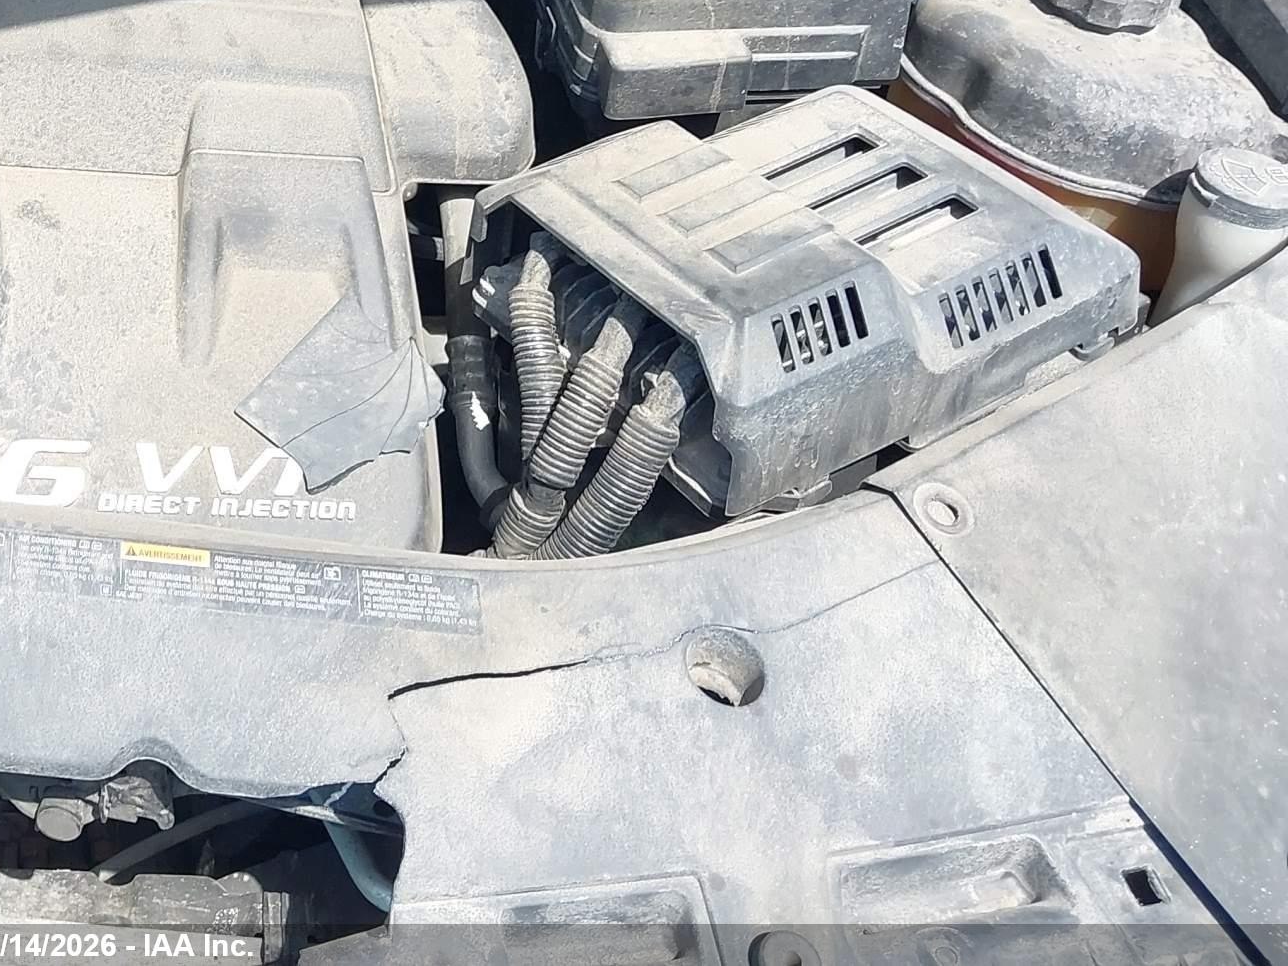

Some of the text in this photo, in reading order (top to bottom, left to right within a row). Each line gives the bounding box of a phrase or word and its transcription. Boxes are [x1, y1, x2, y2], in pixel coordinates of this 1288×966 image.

[97, 493, 357, 520] DIRECT INJECTION
[138, 548, 203, 562] AVERTISSEMENT
[362, 570, 405, 581] CLIMATISEUR
